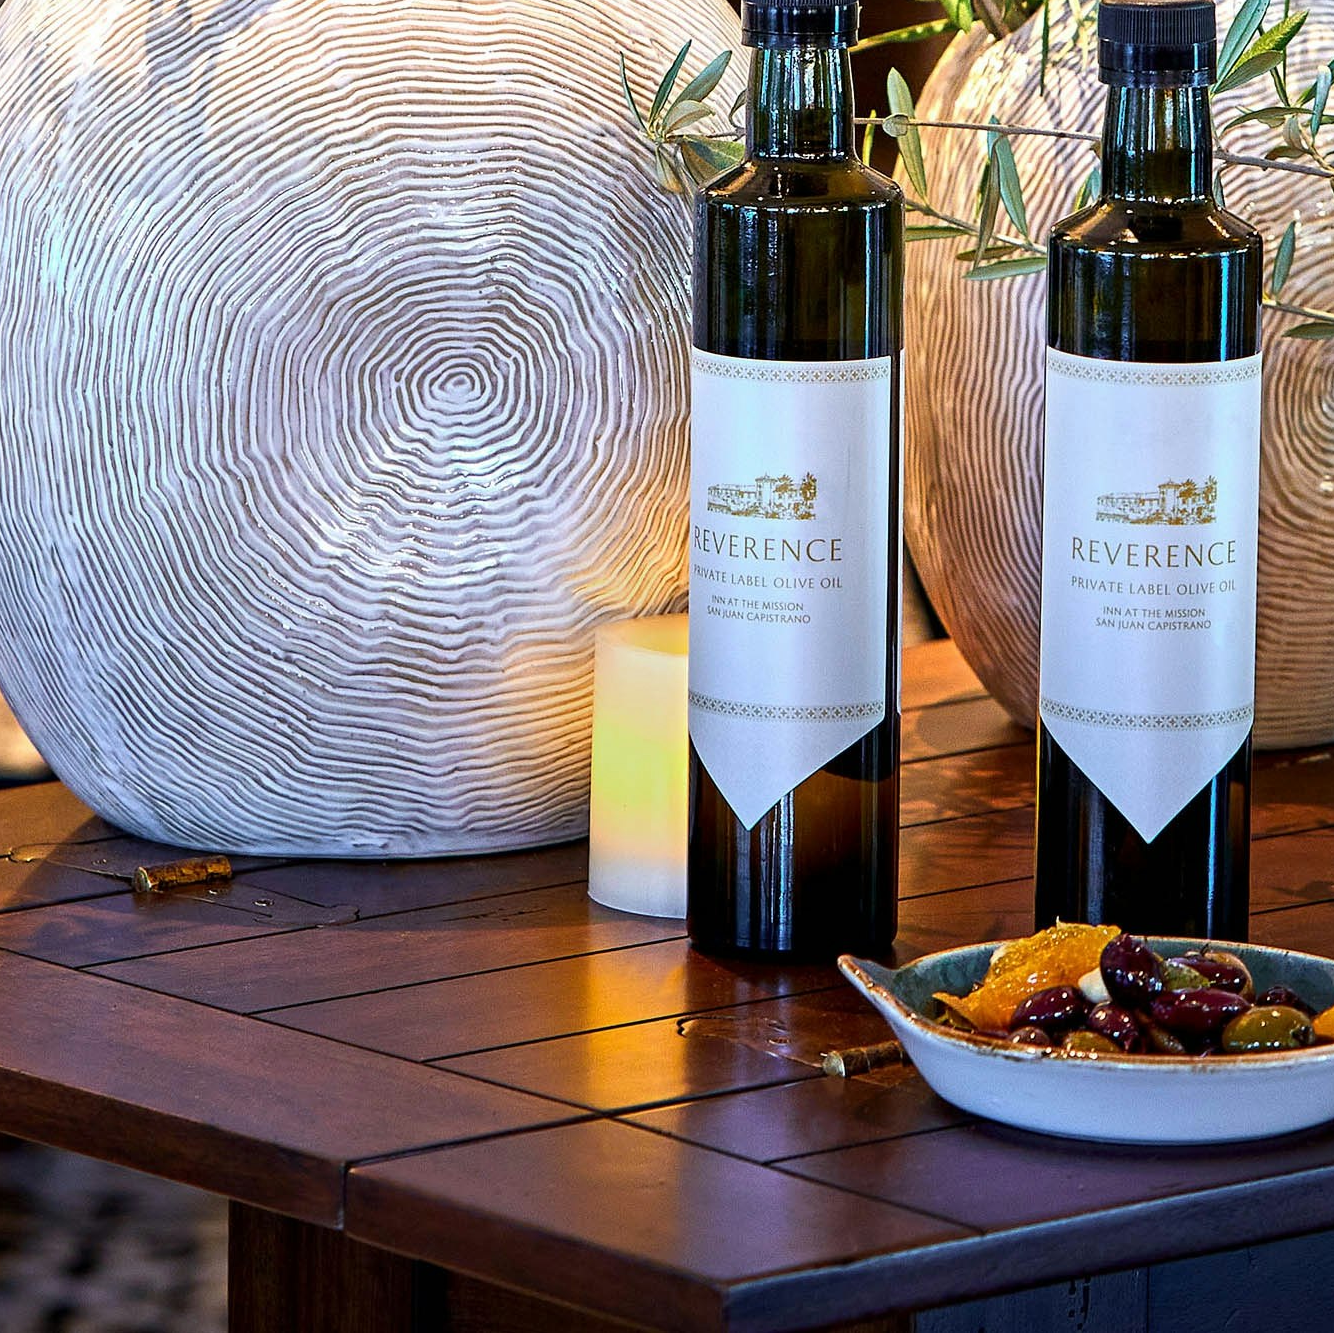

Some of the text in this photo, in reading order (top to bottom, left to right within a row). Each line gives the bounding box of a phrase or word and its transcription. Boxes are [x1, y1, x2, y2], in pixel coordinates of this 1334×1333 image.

[694, 526, 842, 562] REVERENCE
[1072, 537, 1236, 568] REVERENCE
[694, 564, 842, 589] PRIVATE LABEL OLIVE OIL
[1072, 576, 1235, 595] PRIVATE LABEL OLIVE OIL
[712, 595, 803, 611] INN AT THE MISSION
[1103, 606, 1205, 618] INN AT THE MISSION
[707, 605, 810, 624] SAN JUAN CAPISTRANO
[1096, 618, 1211, 630] SAN JUAN CAPISTRANO
